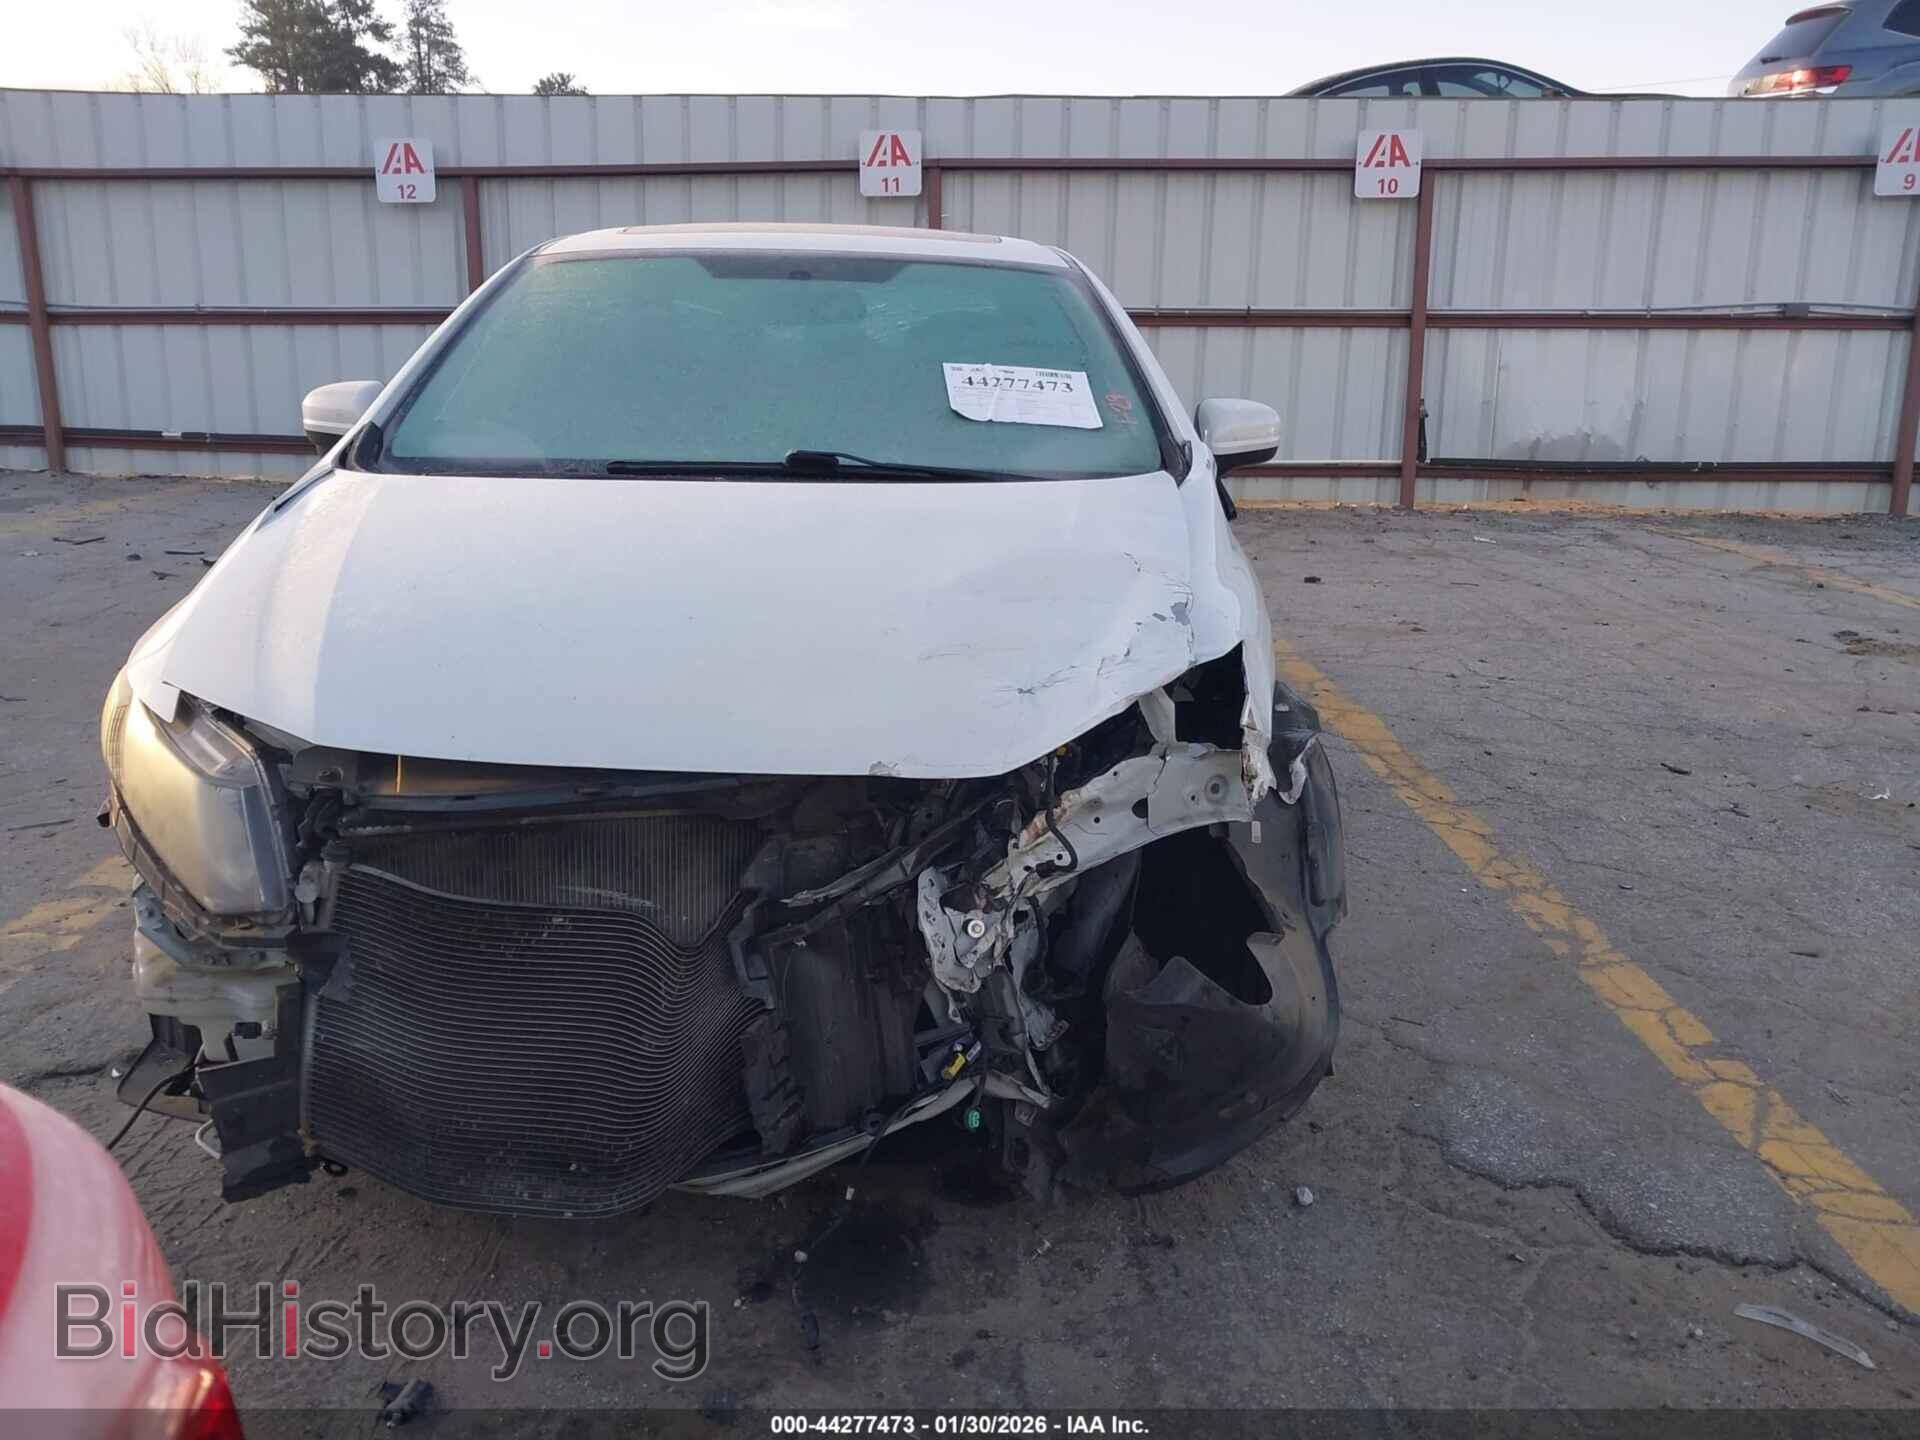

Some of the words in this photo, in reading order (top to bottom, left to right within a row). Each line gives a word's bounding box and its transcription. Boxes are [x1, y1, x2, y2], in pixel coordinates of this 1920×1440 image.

[881, 177, 900, 192] 11
[1377, 178, 1398, 193] 10
[1903, 173, 1916, 190] 9
[397, 184, 417, 199] 12
[961, 375, 1073, 393] 44277473
